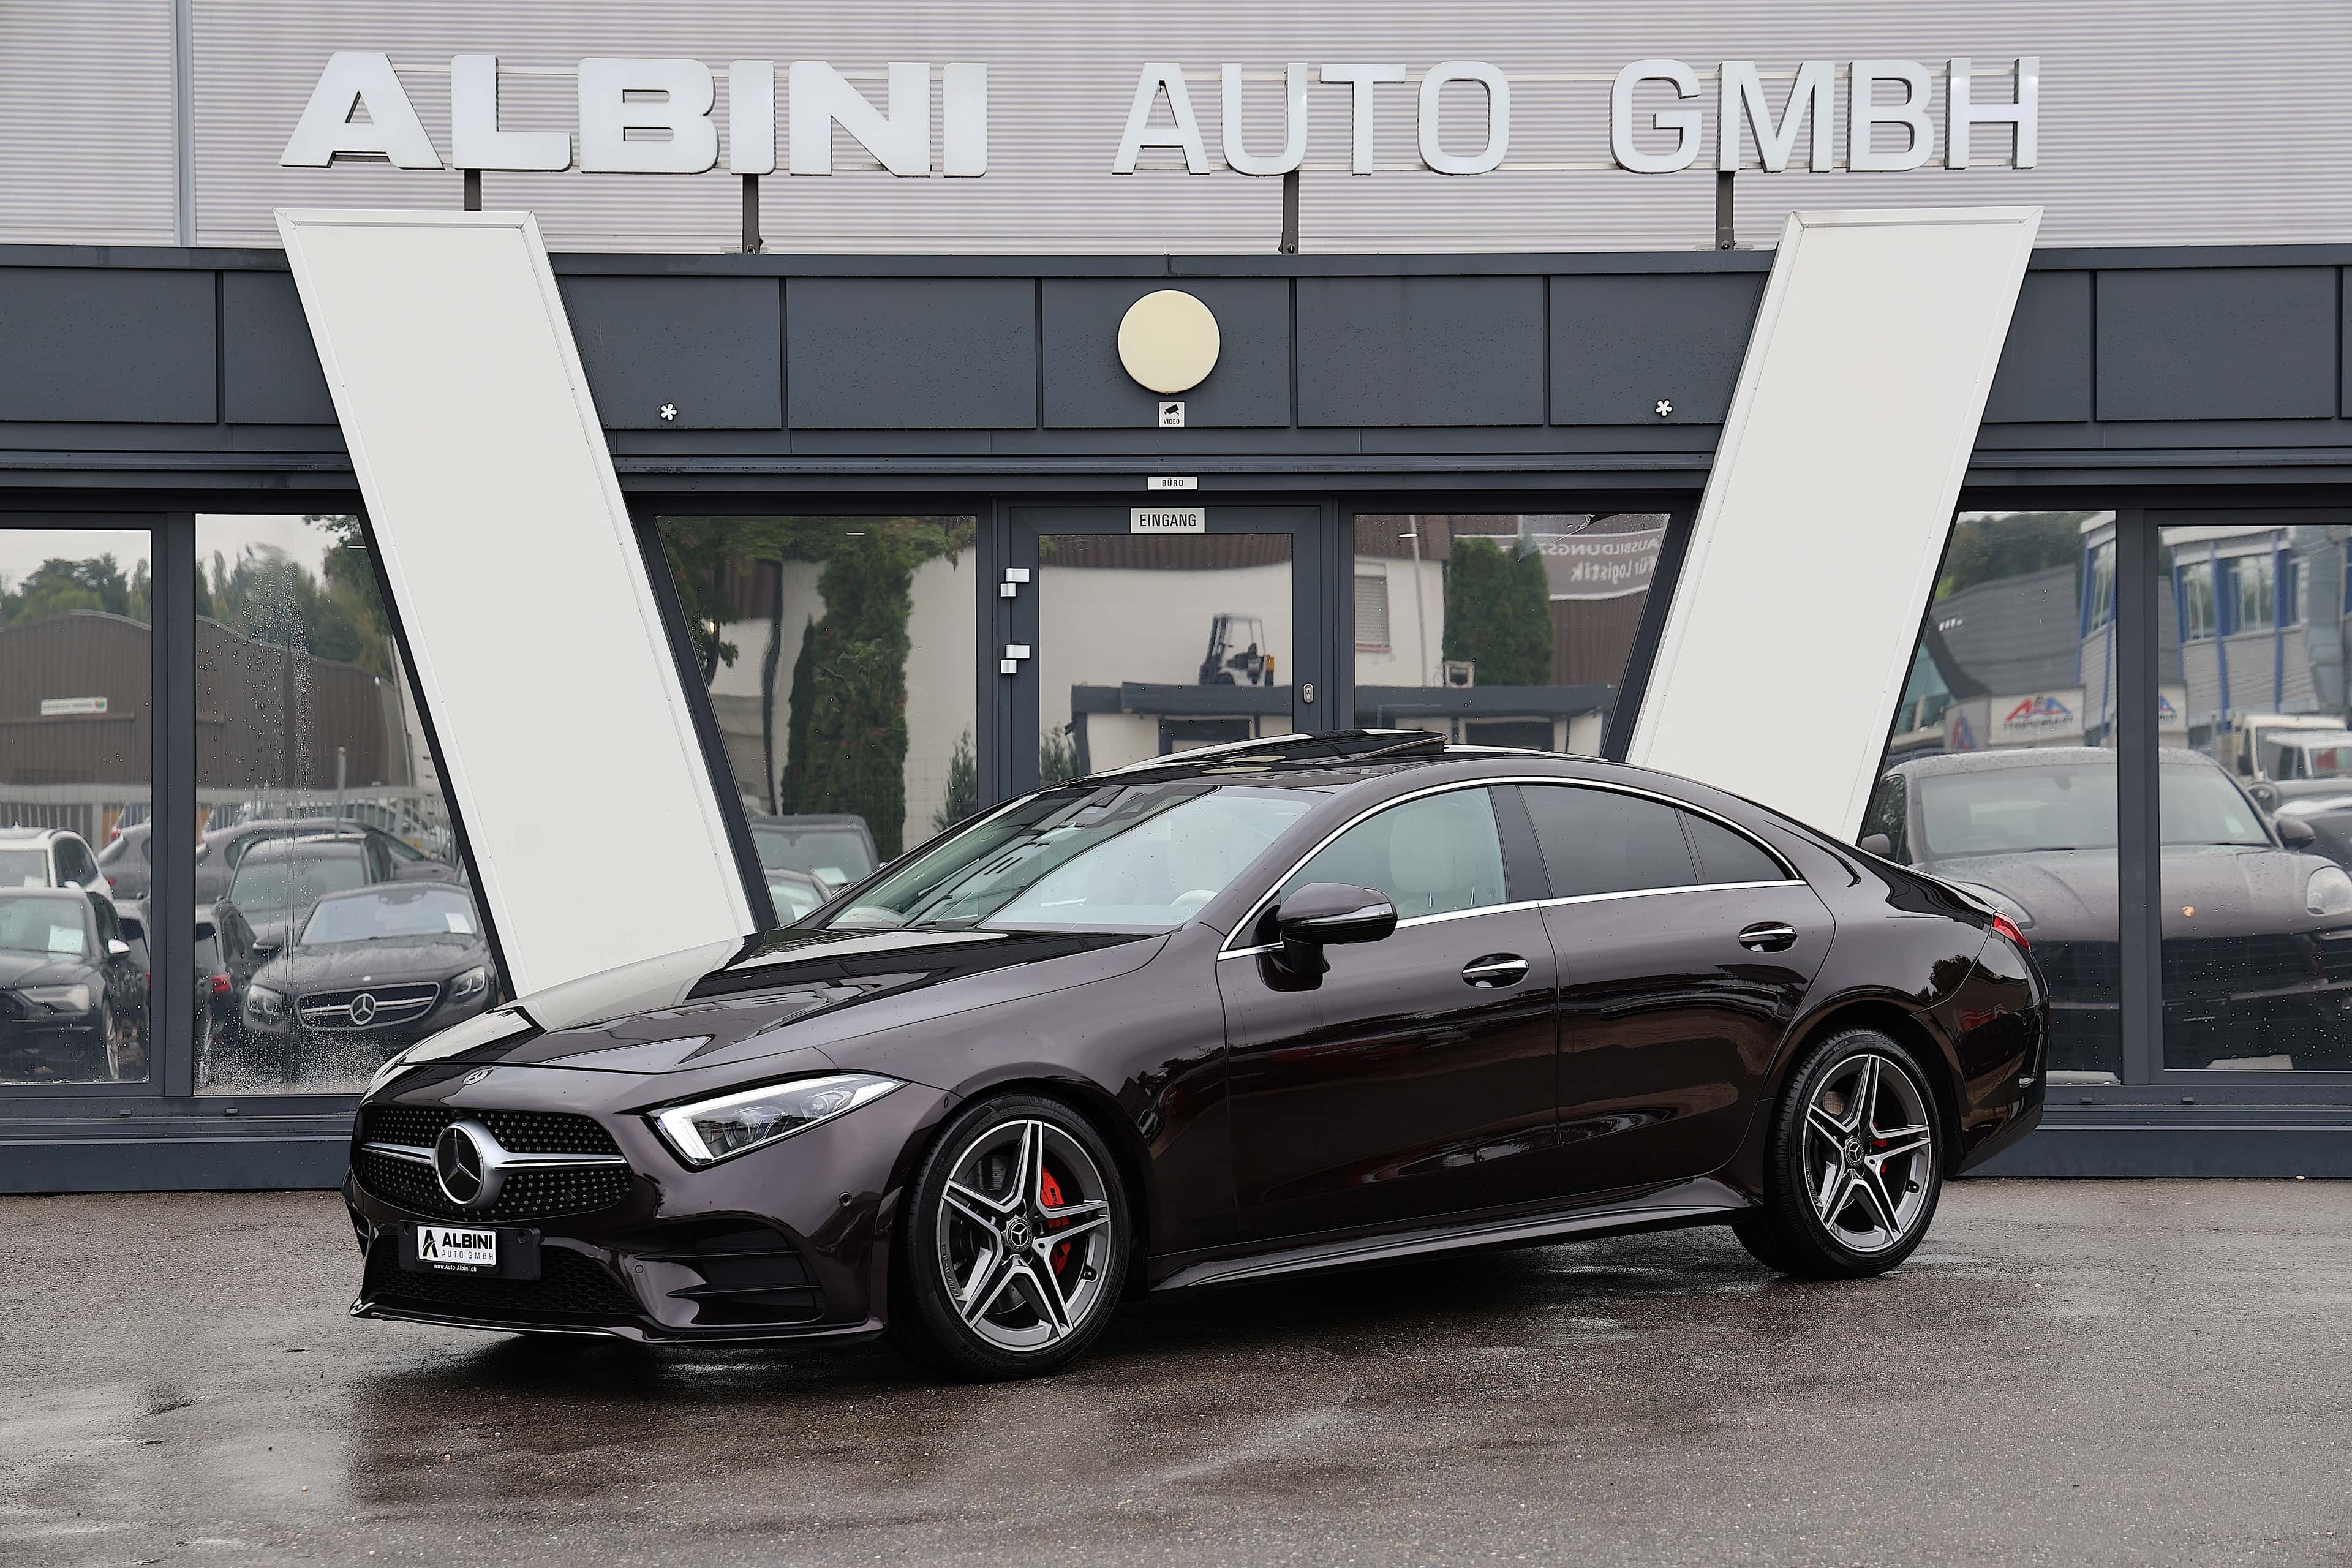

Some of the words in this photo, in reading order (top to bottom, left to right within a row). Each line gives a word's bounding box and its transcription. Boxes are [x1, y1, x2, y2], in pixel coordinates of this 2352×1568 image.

[278, 51, 988, 178] ALBINI
[1112, 61, 1510, 177] AUTO
[1609, 56, 2041, 175] GMBH
[1140, 513, 1196, 527] EINGANG
[442, 1232, 492, 1250] ALBINI
[442, 1250, 464, 1259] AUTO
[468, 1251, 494, 1260] GMBH
[434, 1264, 477, 1272] www.Auto-Albini.ch
